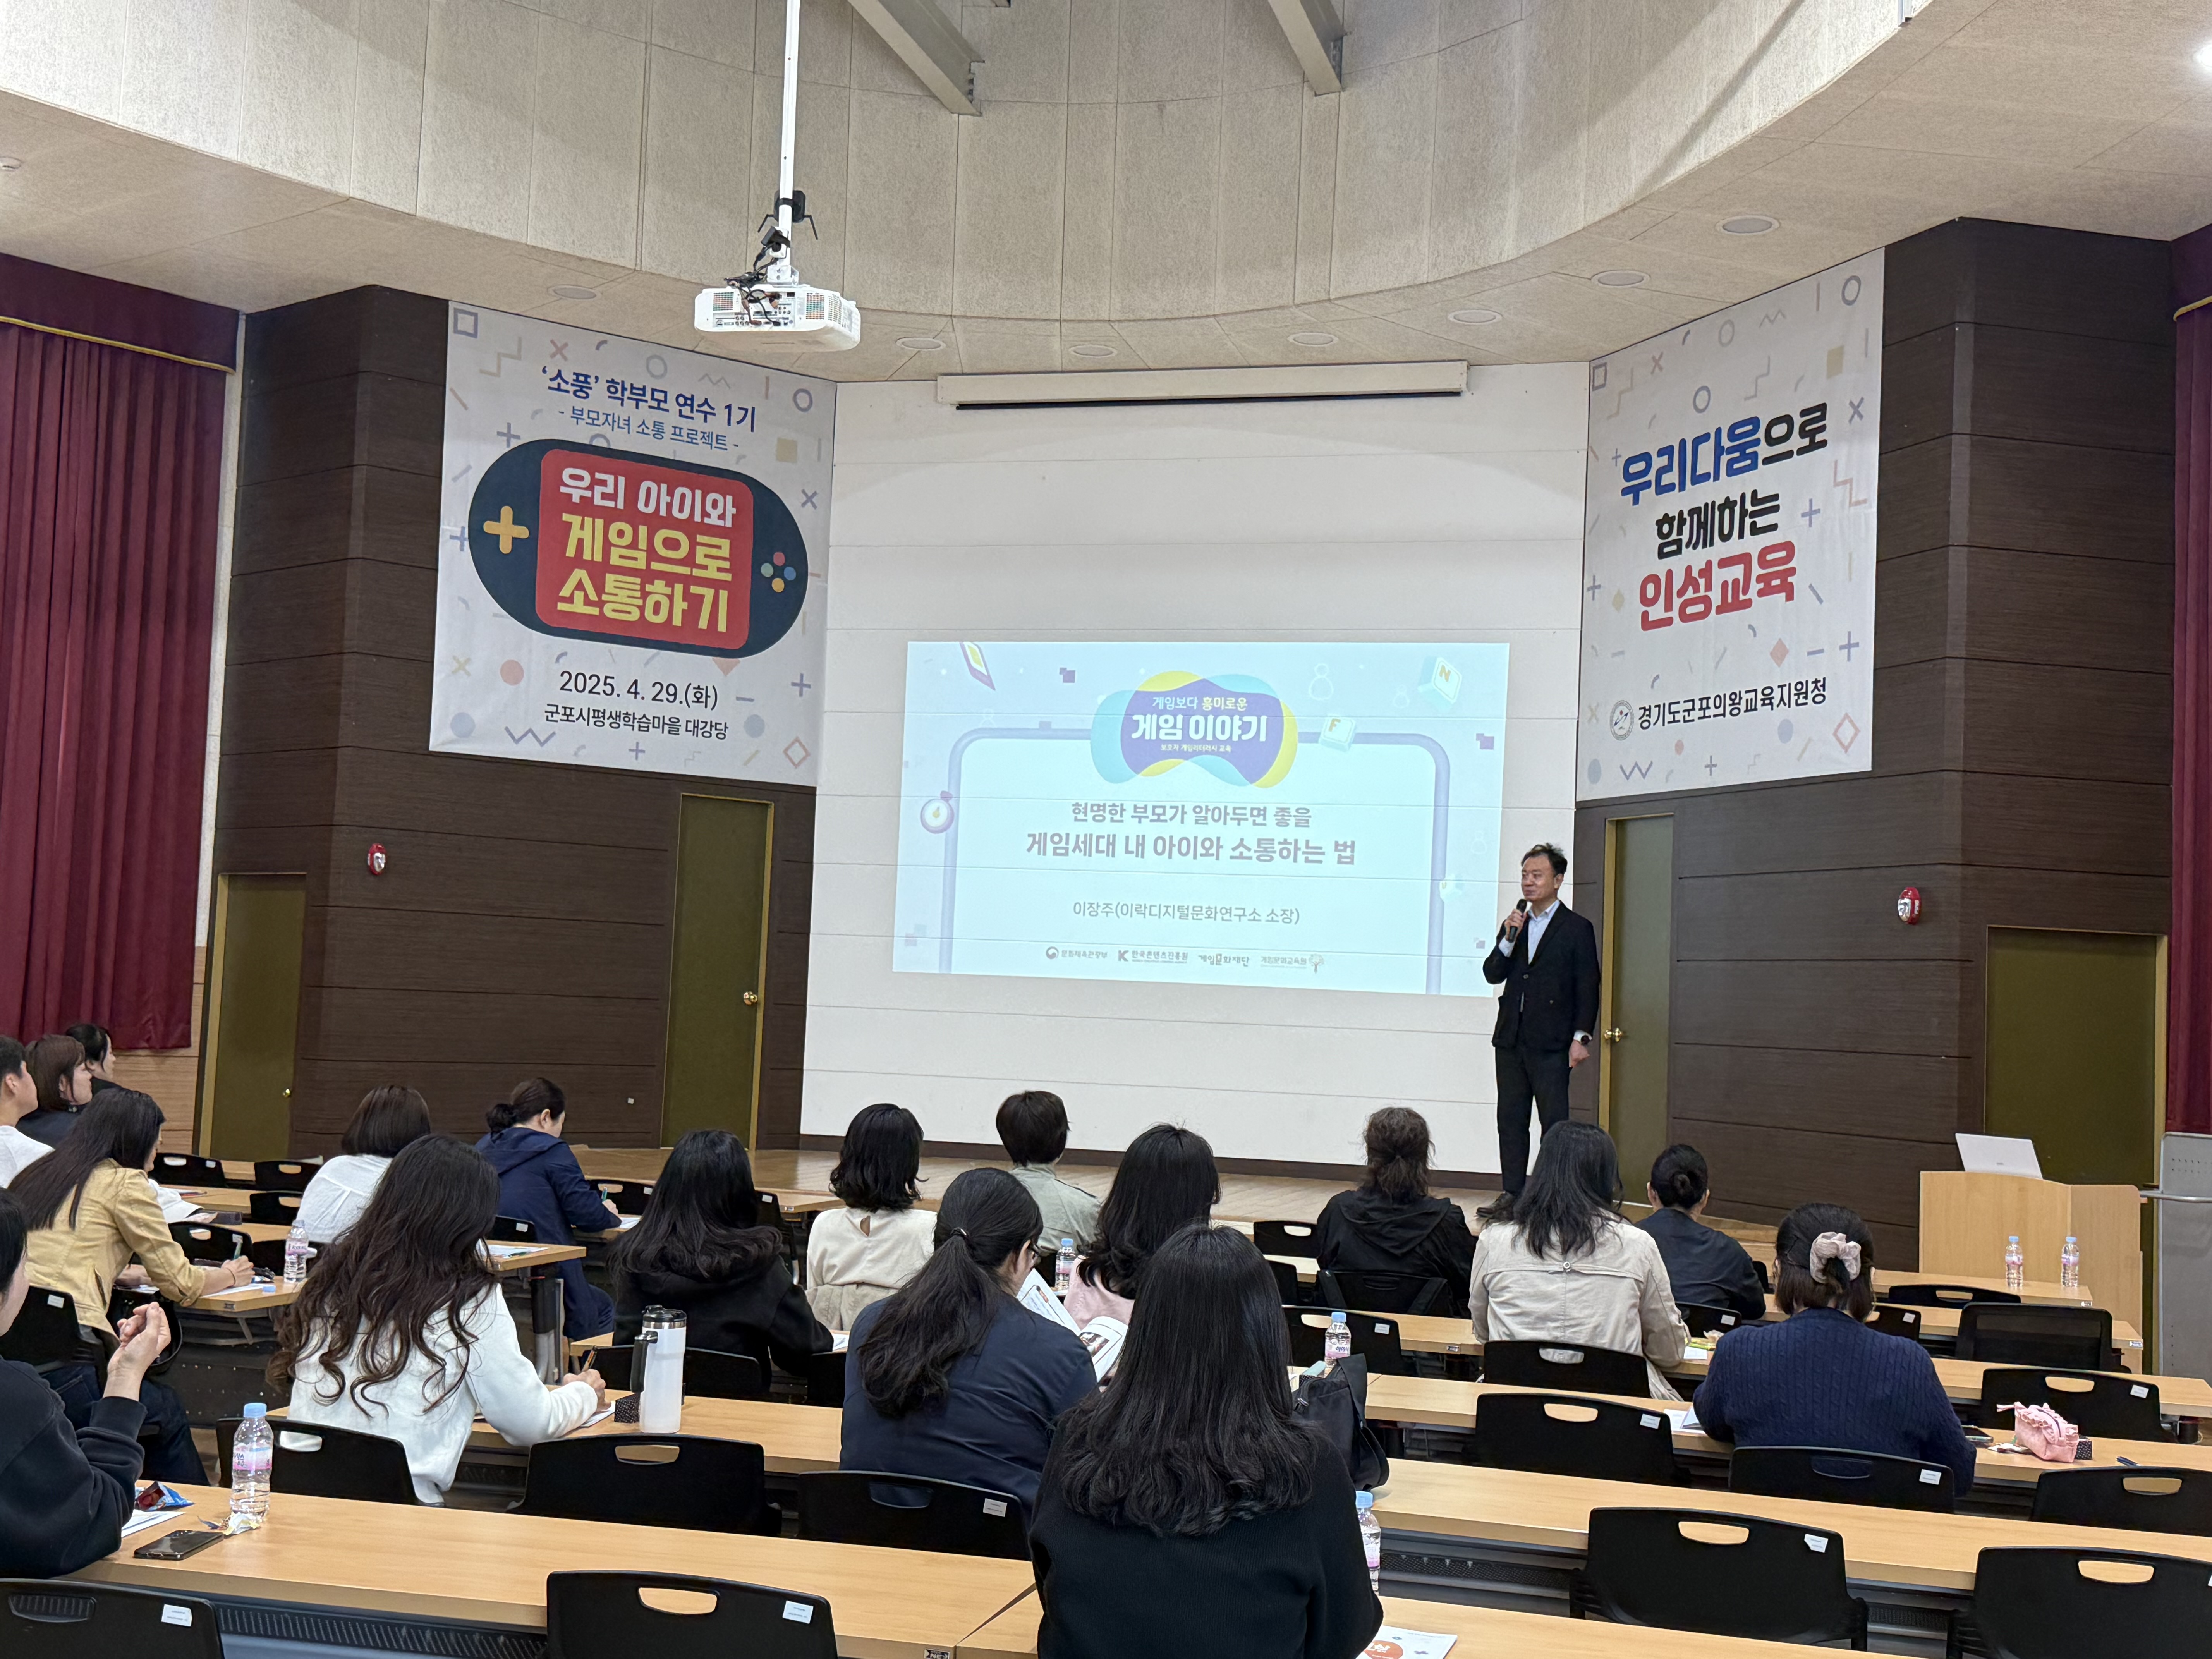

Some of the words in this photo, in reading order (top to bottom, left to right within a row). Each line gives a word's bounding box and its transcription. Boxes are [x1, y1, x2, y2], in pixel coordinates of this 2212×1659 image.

[570, 405, 630, 434] 부모자녀
[636, 419, 666, 439] 소통
[670, 426, 728, 450] 프로젝트
[606, 378, 669, 412] 학부모
[675, 393, 715, 421] 연수
[724, 404, 756, 432] 1기
[1621, 402, 1827, 506] 우리다움으로
[560, 467, 625, 509] 우리
[637, 481, 736, 528] 아이와
[562, 513, 732, 582] 게임으로
[1656, 489, 1780, 560] 함께하는
[557, 569, 728, 633] 소통하기
[1640, 540, 1796, 631] 인성교육
[559, 670, 620, 697] 2025.
[627, 679, 645, 701] 4.
[651, 682, 718, 710] 29.(화)
[1152, 697, 1198, 710] 게임보다
[1202, 697, 1247, 711] 흥미로운
[1638, 677, 1827, 730] 경기도군포의왕교육지원청
[544, 703, 682, 736] 군포시평생학습마을
[685, 718, 728, 741] 대강당
[1131, 714, 1183, 740] 게임
[1189, 714, 1267, 742] 이야기
[1072, 802, 1126, 823] 현명한
[1131, 804, 1187, 824] 부모가
[1192, 805, 1267, 826] 알아두면
[1274, 807, 1312, 828] 좋을
[1026, 832, 1116, 858] 게임세대
[1125, 834, 1146, 859] 내
[1153, 835, 1223, 861] 아이와
[1230, 838, 1325, 864] 소통하는
[1334, 840, 1355, 865] 법
[1073, 901, 1262, 922] 이장주(이락디지털문화연구소
[1265, 907, 1300, 925] 소장)
